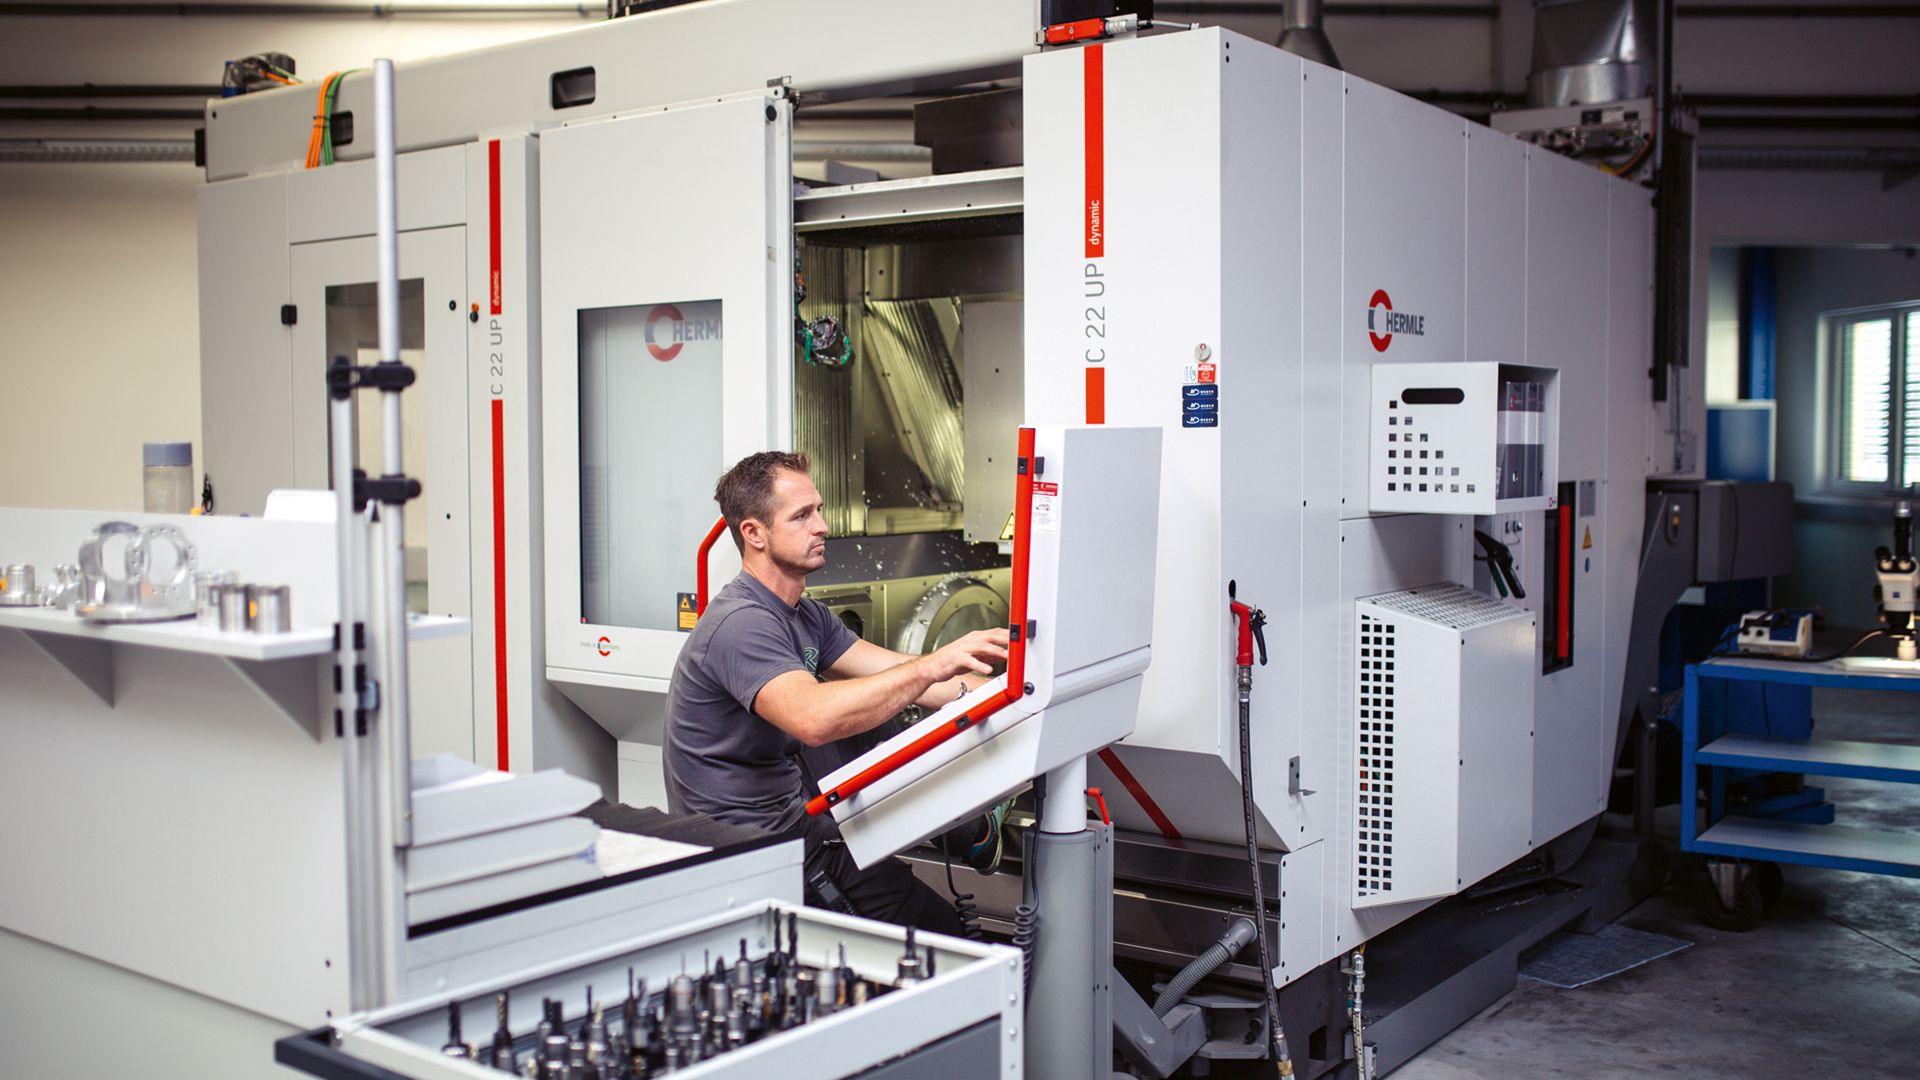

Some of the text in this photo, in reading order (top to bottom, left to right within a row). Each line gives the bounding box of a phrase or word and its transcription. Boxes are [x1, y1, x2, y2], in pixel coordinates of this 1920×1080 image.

[1089, 199, 1101, 245] dynamic
[672, 319, 722, 342] HERM
[1085, 263, 1105, 363] C 22 UP
[1386, 311, 1425, 336] HERMLE
[490, 319, 503, 396] C 22 UP
